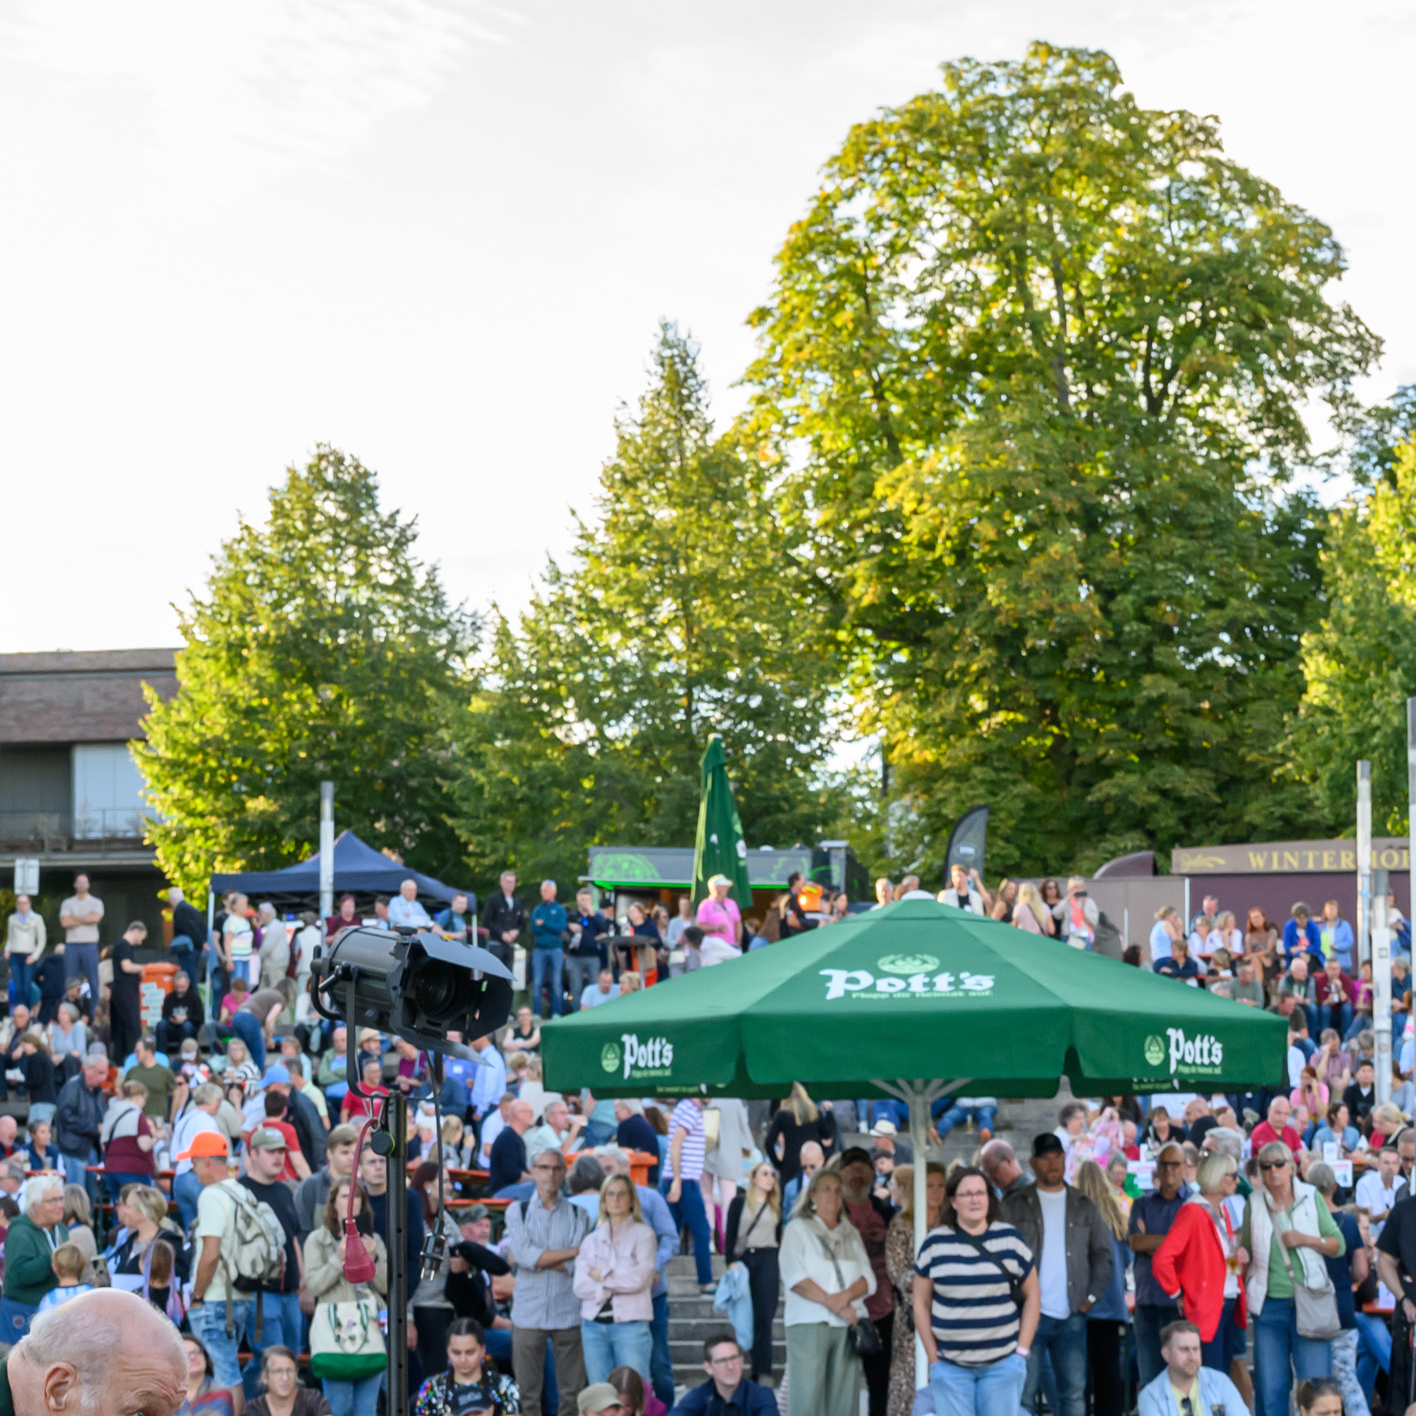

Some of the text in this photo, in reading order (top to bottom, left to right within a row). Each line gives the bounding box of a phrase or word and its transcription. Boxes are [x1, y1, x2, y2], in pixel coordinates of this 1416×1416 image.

[819, 969, 996, 1000] Pott's
[621, 1033, 674, 1080] Pott's
[1166, 1027, 1223, 1075] Pott's
